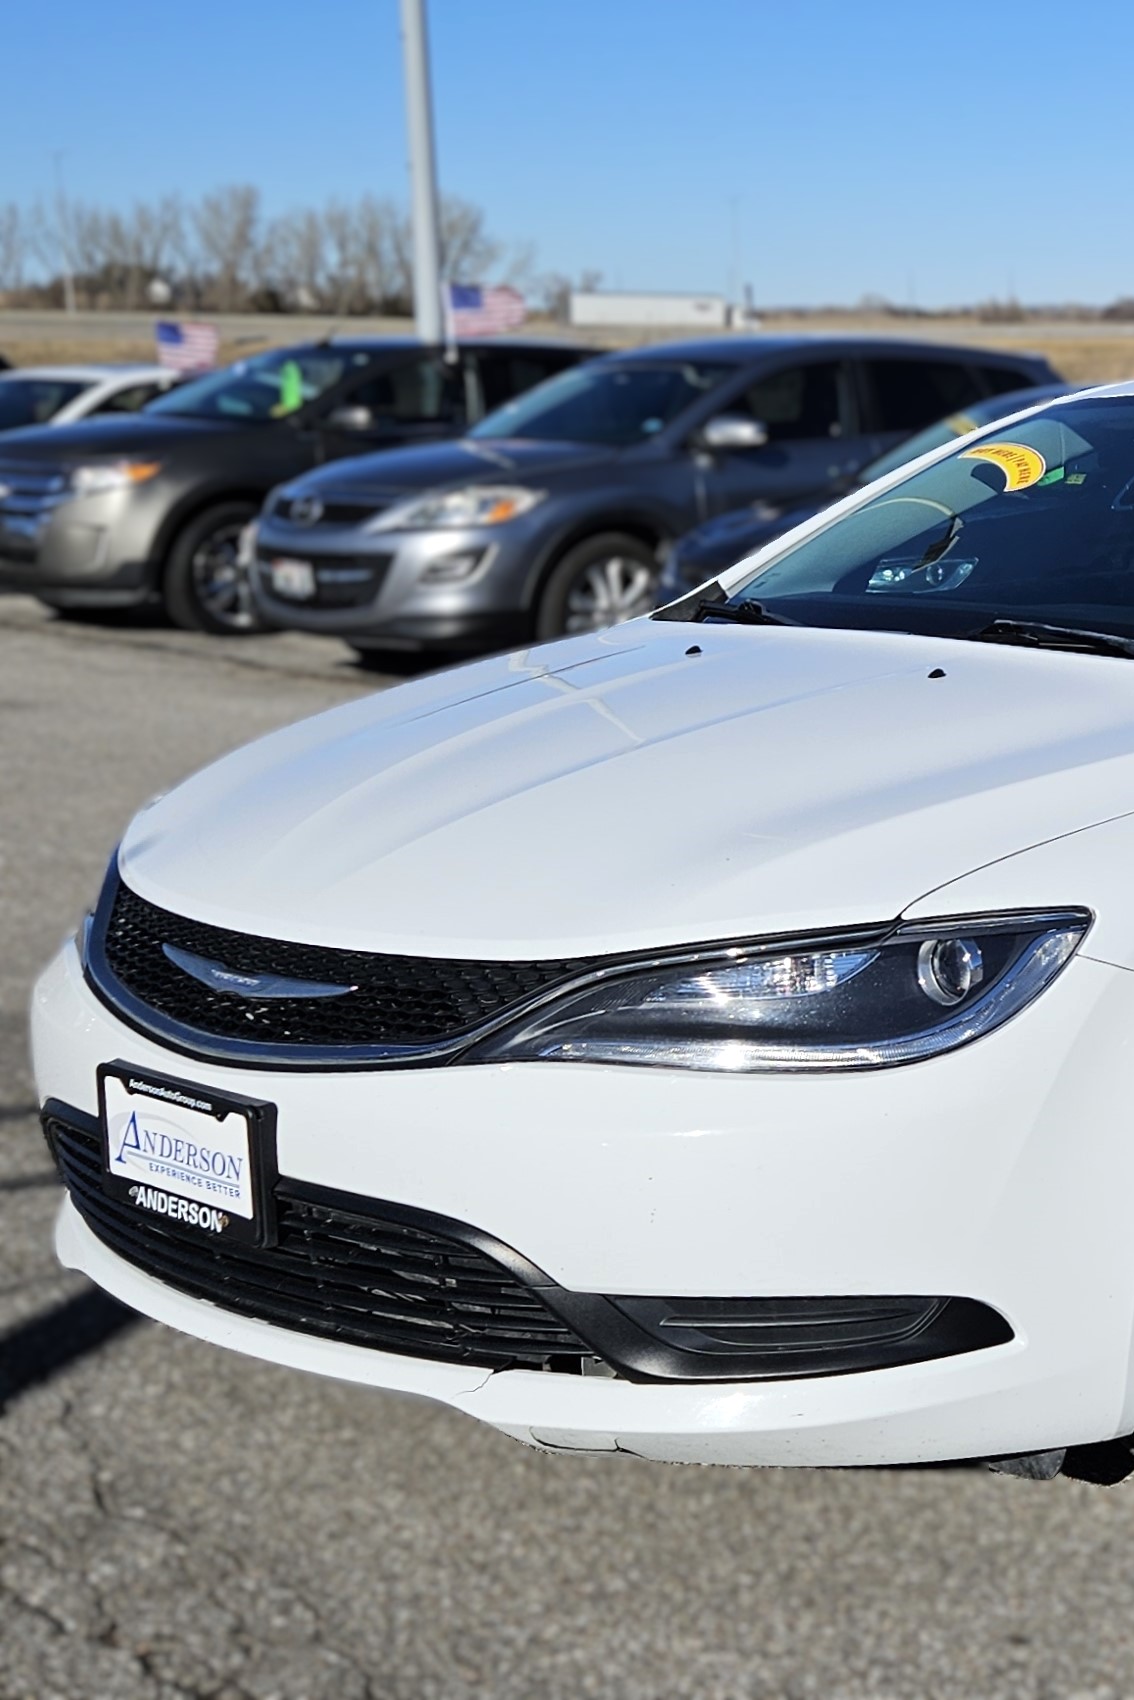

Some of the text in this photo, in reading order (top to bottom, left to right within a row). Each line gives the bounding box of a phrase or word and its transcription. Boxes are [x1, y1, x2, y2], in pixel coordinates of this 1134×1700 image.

[115, 1110, 243, 1181] ANDERSON
[149, 1162, 241, 1199] EXPERIENCE BETTER
[135, 1186, 224, 1233] ANDERSON
